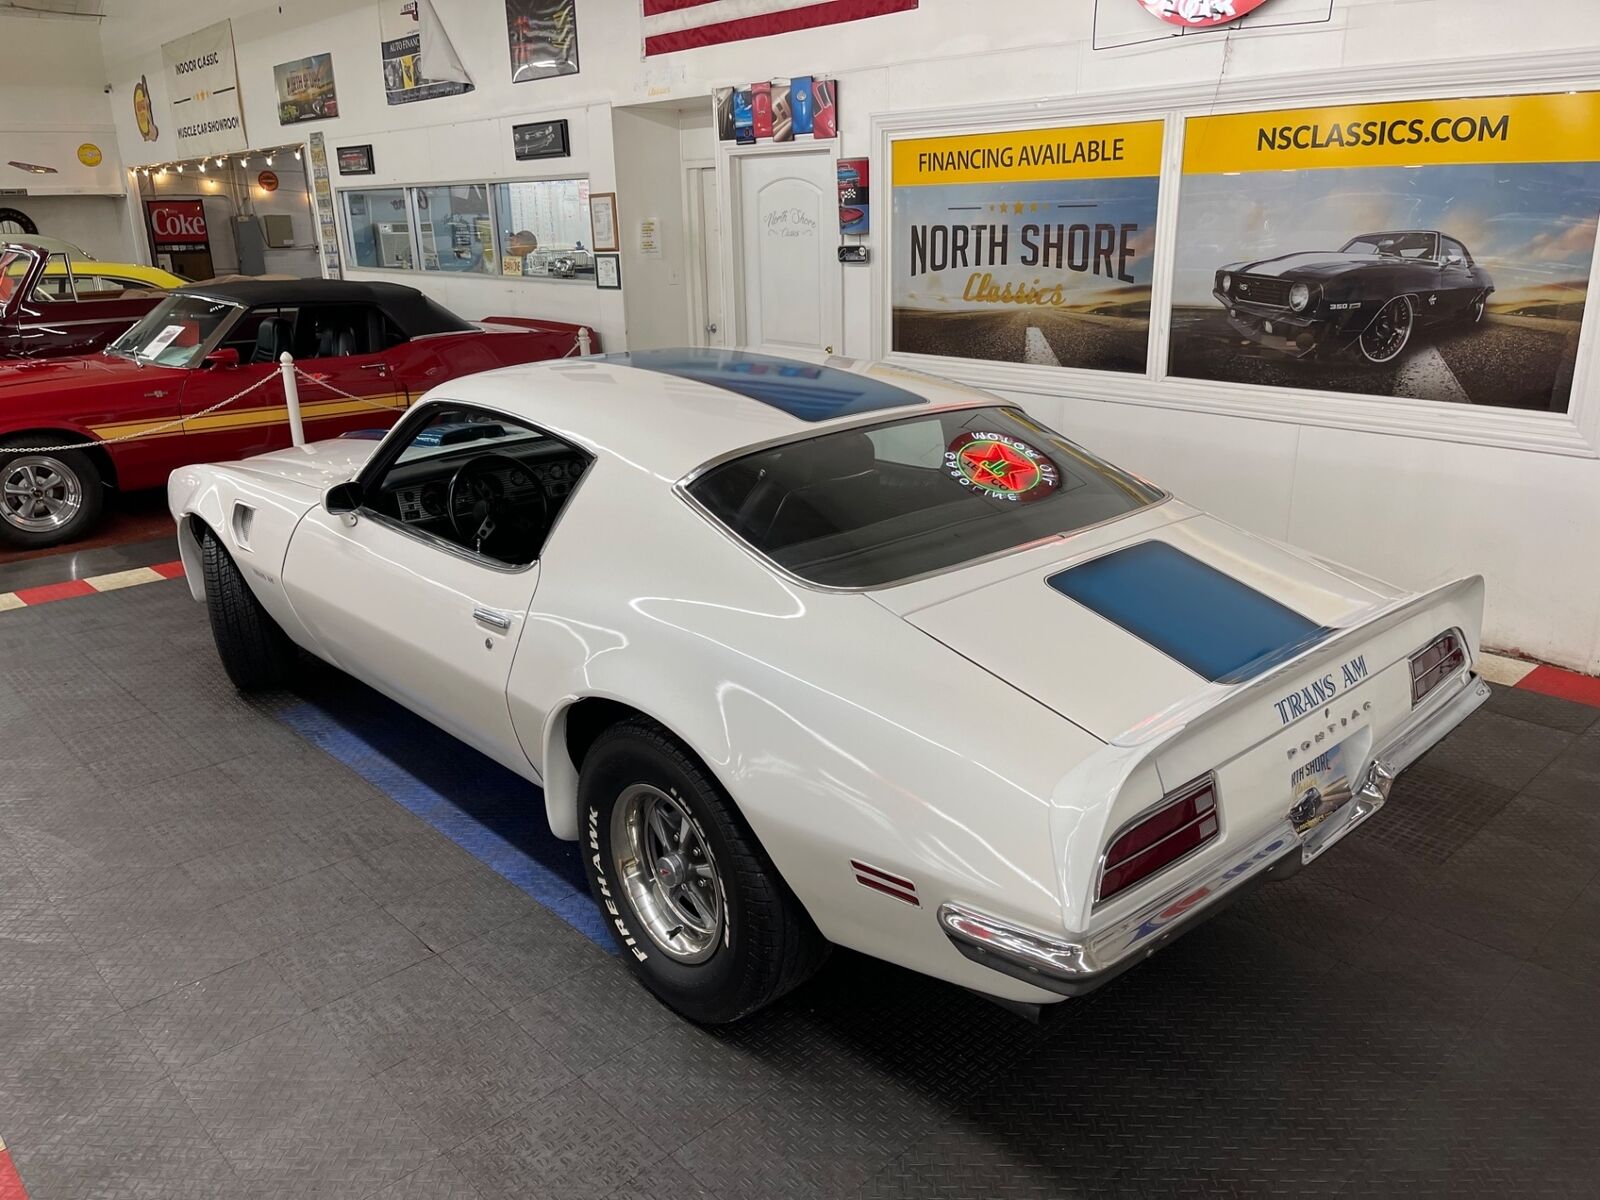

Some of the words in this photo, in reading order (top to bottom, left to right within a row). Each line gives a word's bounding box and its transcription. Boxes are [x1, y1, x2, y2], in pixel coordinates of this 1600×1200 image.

[175, 59, 197, 76] INDOOR
[197, 51, 219, 69] CLASSIC
[389, 40, 403, 53] AUTO
[177, 125, 198, 140] MUSCLE
[197, 122, 208, 136] CAR
[207, 116, 240, 134] SHOWROOM
[1256, 114, 1510, 152] NSCLASSICS.COM
[918, 146, 1014, 173] FINANCING
[1017, 137, 1125, 168] AVAILABLE
[151, 208, 206, 236] Coke
[910, 223, 1009, 277] NORTH
[1020, 222, 1139, 285] SHORE
[962, 272, 1067, 307] Classics
[1274, 673, 1337, 725] TRANS
[1341, 654, 1369, 689] AM
[1287, 700, 1373, 760] PONTIAC
[1305, 754, 1332, 779] SHORE
[588, 805, 649, 963] FIREHAWK
